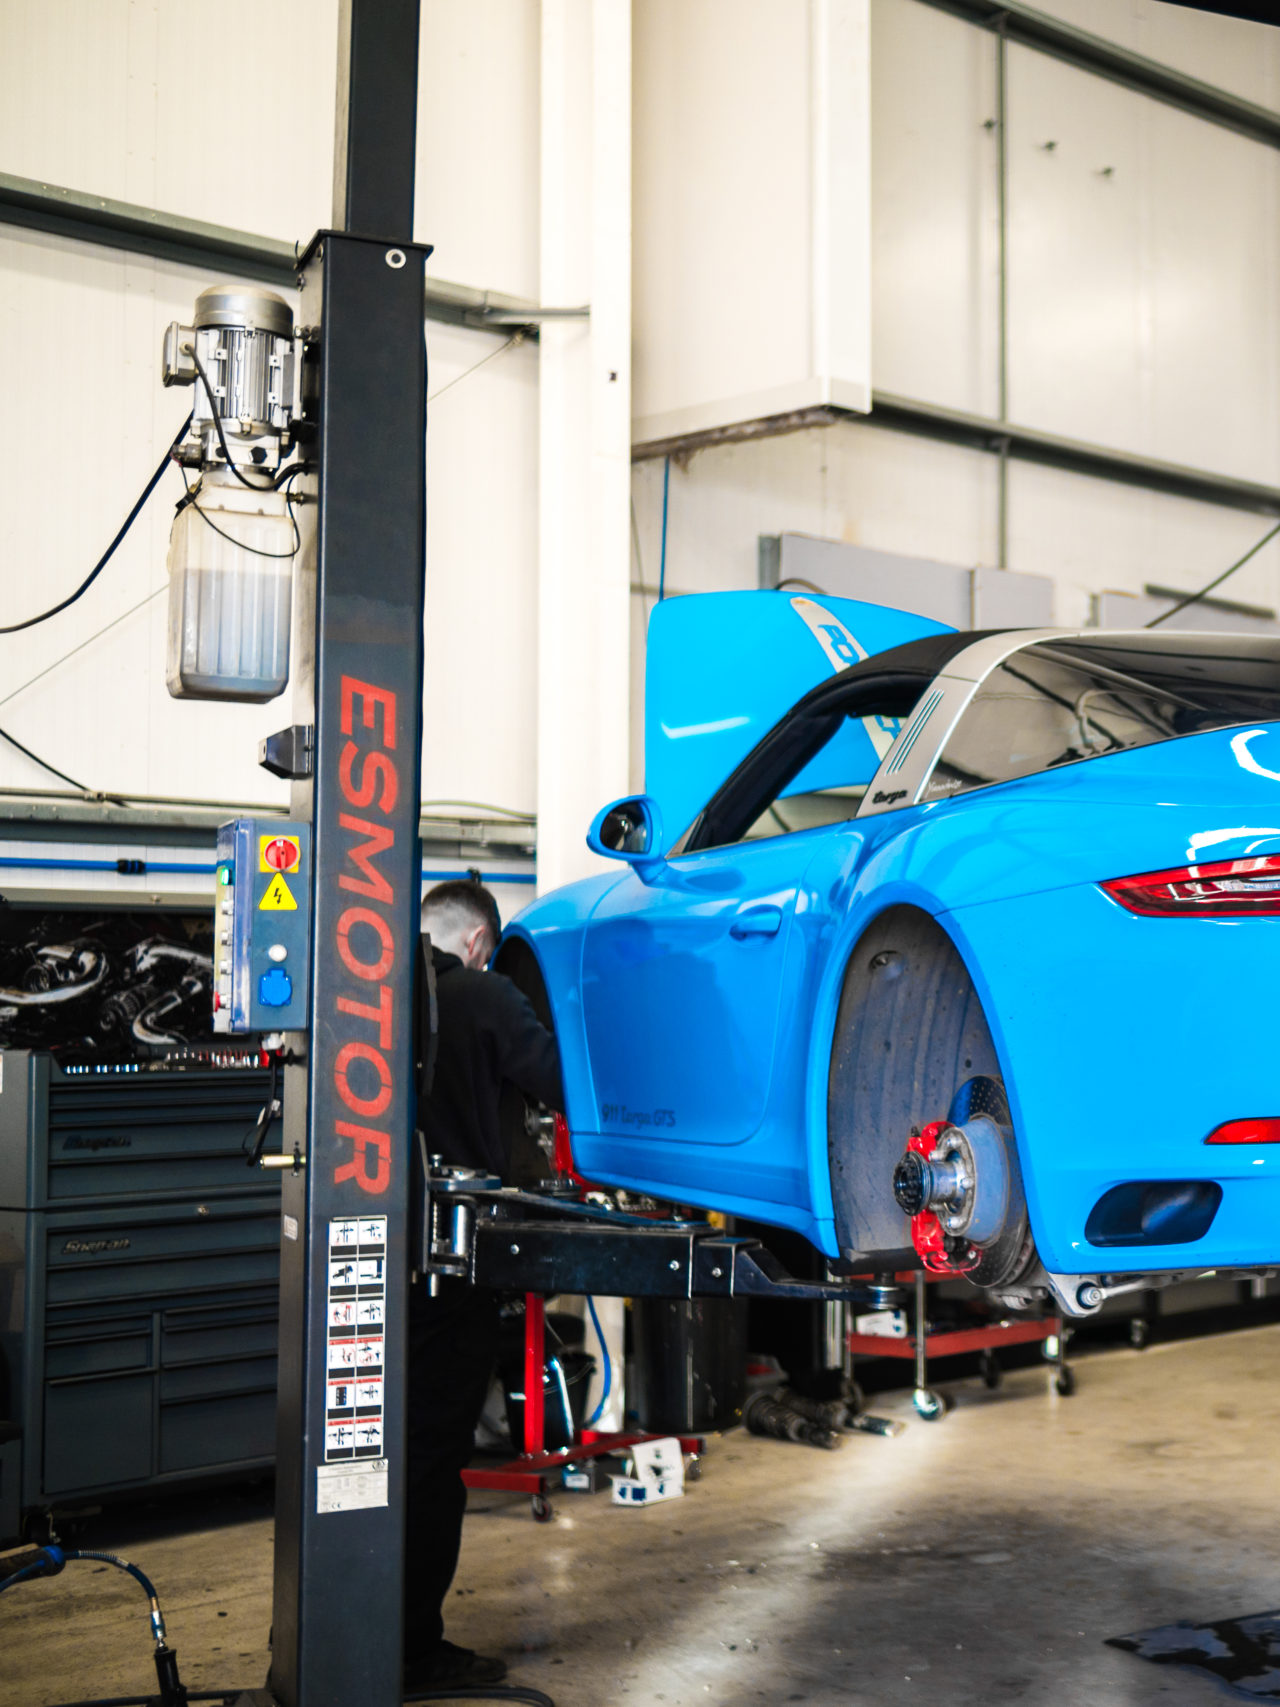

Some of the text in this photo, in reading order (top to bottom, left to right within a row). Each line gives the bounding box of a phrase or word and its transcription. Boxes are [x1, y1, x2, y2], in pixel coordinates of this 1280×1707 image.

[333, 674, 399, 1196] ESMOTOR
[602, 1103, 619, 1122] 911
[653, 1108, 676, 1128] GTS
